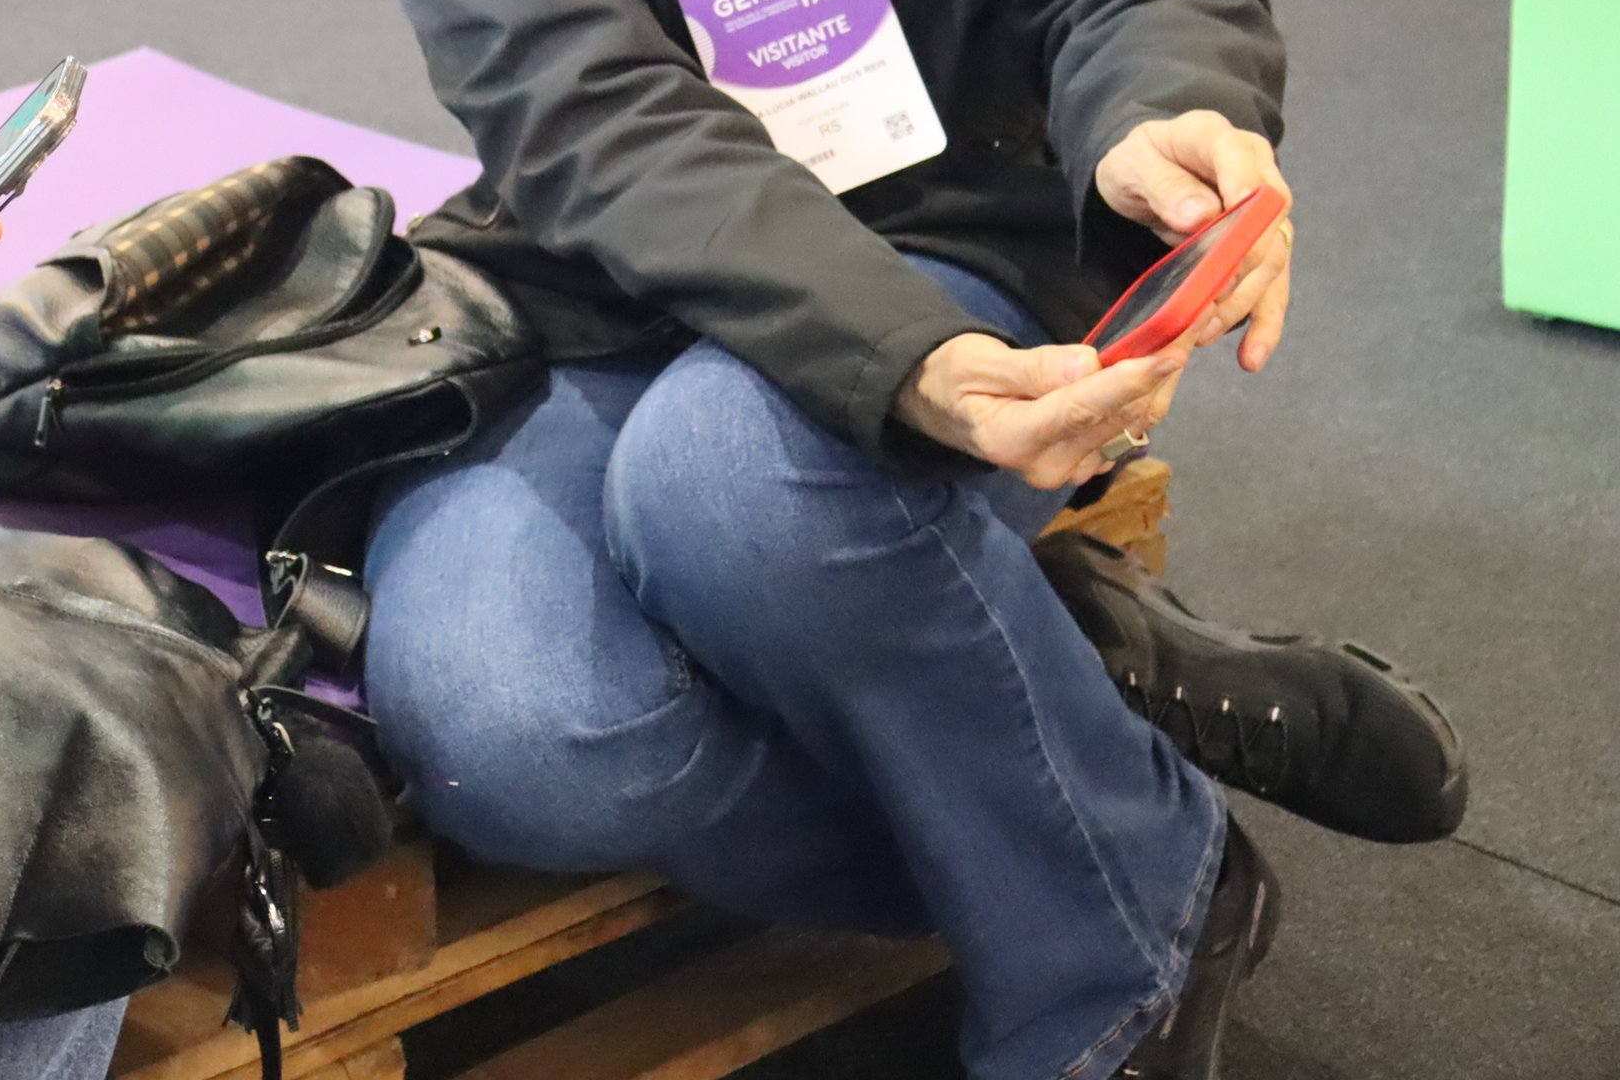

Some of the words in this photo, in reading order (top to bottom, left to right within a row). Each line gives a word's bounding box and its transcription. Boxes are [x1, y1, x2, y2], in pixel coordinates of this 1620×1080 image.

[747, 13, 852, 68] VISITANTE
[781, 43, 829, 71] VISITOR
[818, 119, 843, 137] RS
